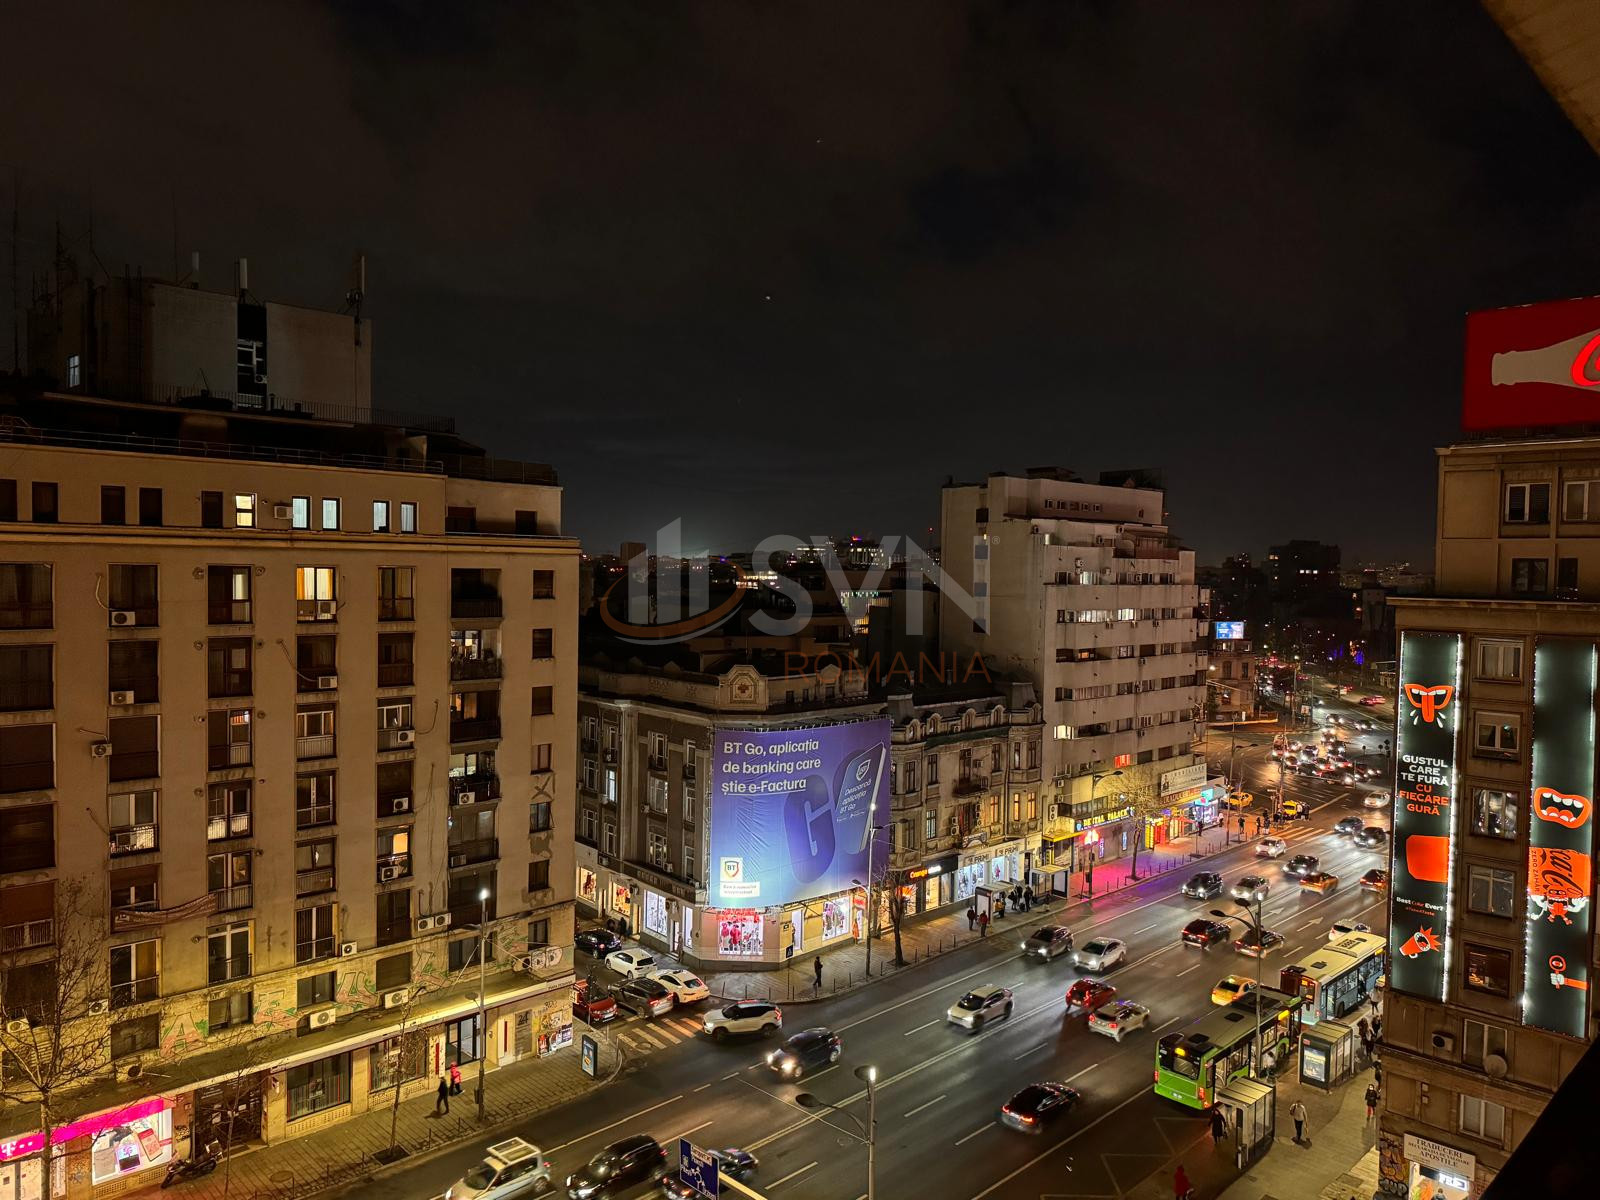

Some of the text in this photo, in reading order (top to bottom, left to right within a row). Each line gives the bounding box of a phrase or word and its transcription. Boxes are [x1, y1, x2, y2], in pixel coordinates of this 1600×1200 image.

[724, 739, 820, 757] BT Go, aplicația
[722, 759, 821, 774] de banking care
[1402, 754, 1449, 768] GUSTUL
[1409, 764, 1441, 776] CARE
[721, 779, 807, 795] știe e-Factura
[1400, 772, 1450, 787] TE FURĂ
[1415, 783, 1433, 793] CU
[1399, 789, 1450, 806] FIECARE
[1406, 803, 1441, 816] GURĂ
